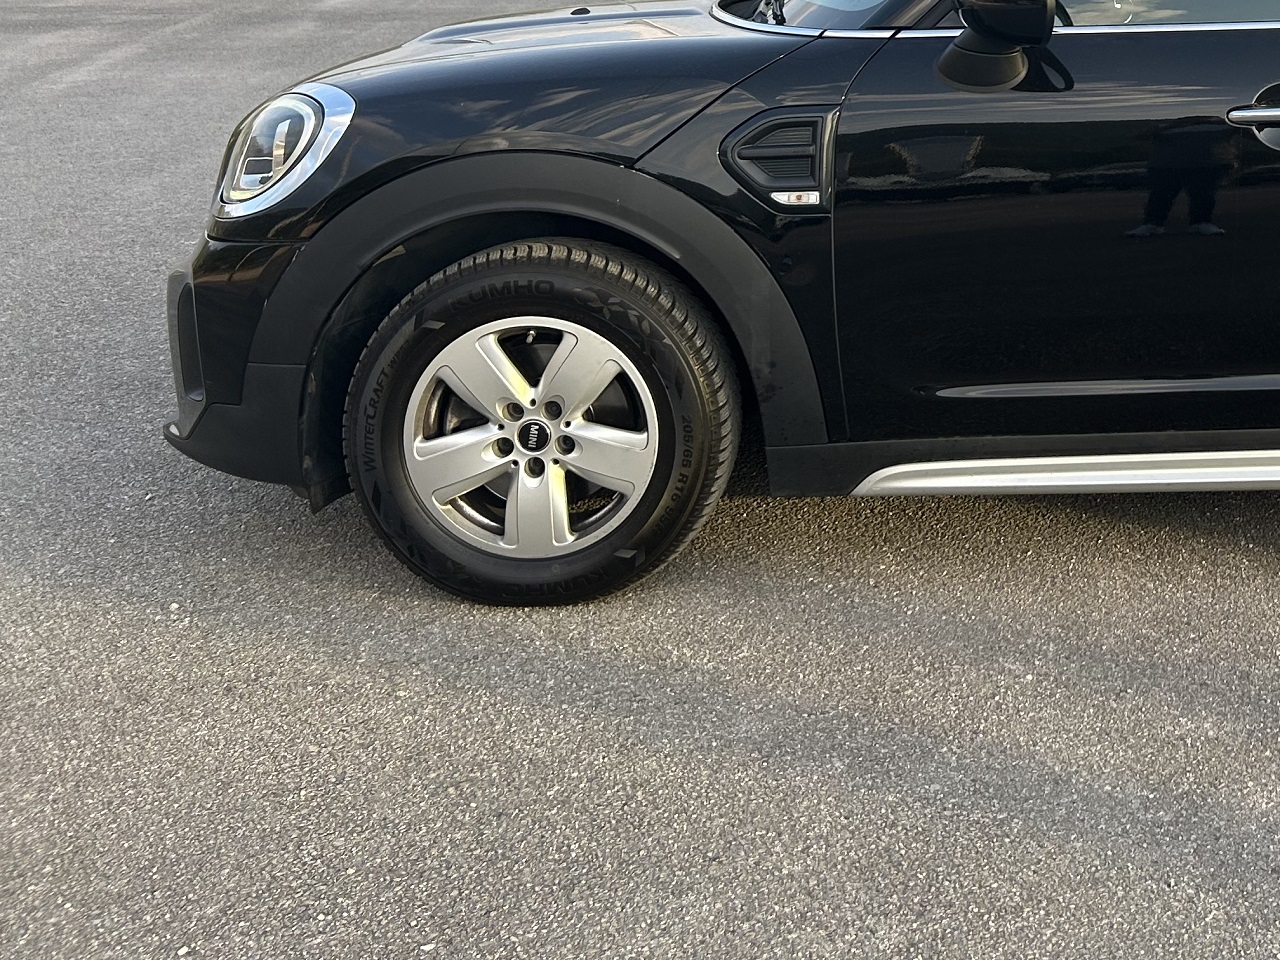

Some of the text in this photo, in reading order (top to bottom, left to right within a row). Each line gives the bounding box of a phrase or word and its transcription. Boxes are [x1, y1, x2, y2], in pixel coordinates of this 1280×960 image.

[448, 279, 555, 313] KUMHO
[528, 424, 539, 448] MINI
[680, 414, 693, 468] 205/65
[670, 472, 689, 504] R16
